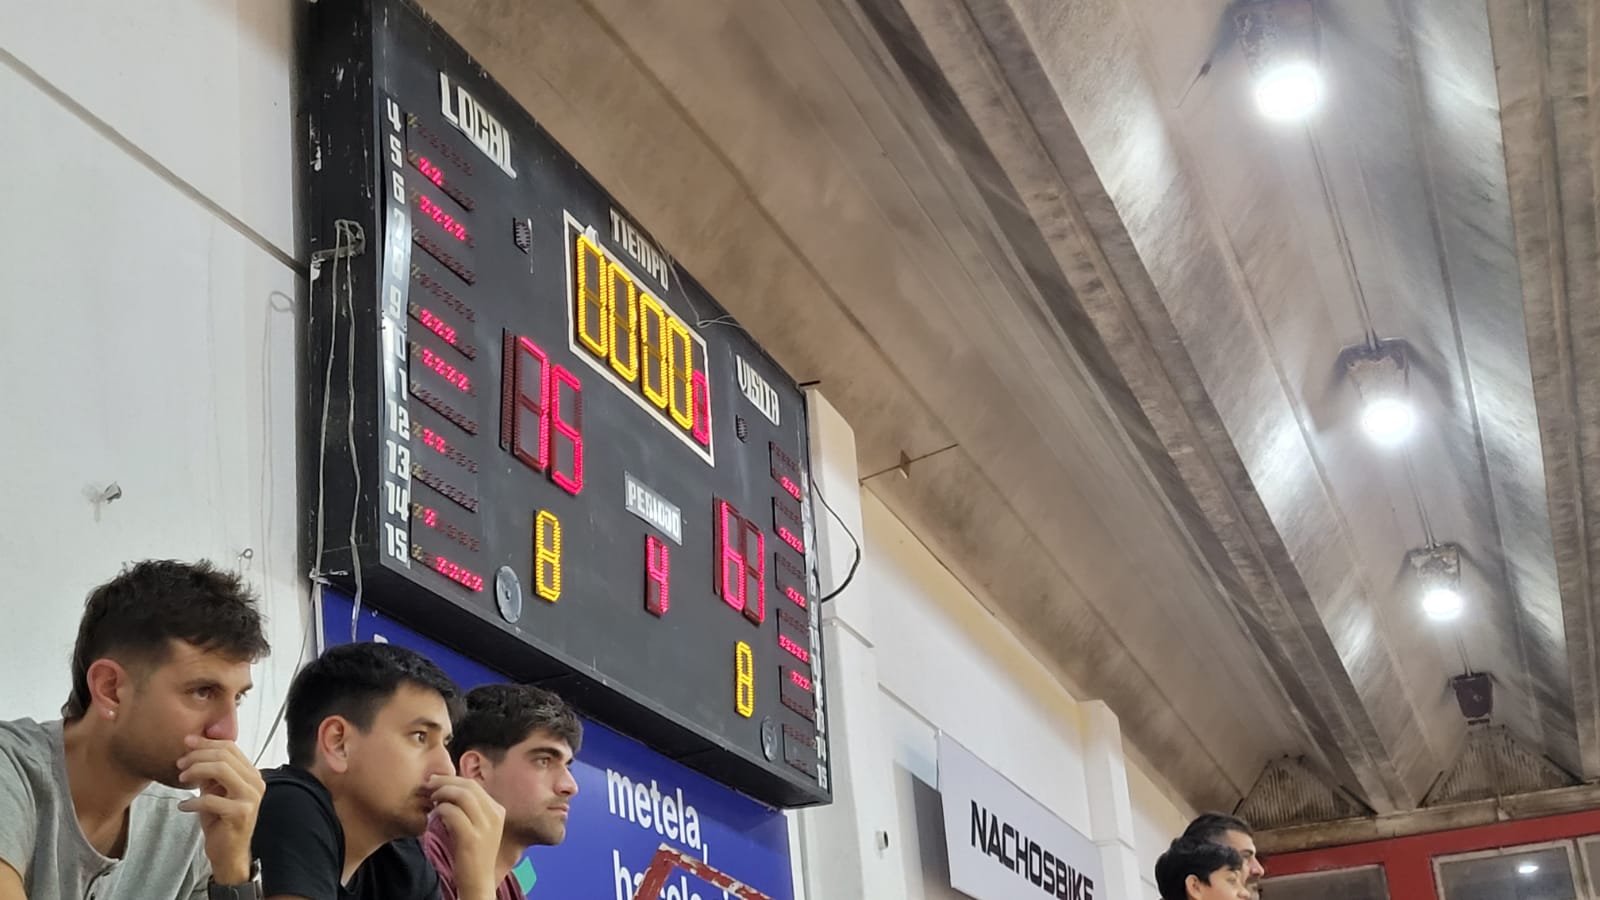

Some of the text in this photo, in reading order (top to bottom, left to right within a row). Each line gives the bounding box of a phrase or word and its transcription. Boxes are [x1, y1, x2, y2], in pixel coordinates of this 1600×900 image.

[386, 97, 402, 133] 4
[439, 71, 518, 180] LOCAL
[389, 133, 403, 169] 5
[392, 170, 405, 205] 6
[609, 207, 670, 292] TIEMPO
[736, 354, 781, 427] VISITA
[387, 400, 410, 441] 12
[386, 440, 410, 481] 13
[384, 481, 410, 522] 14
[384, 522, 408, 564] 15
[535, 509, 561, 602] 8
[647, 535, 670, 615] 4
[735, 640, 754, 718] 8
[970, 799, 1095, 900] NACHOSBIKE
